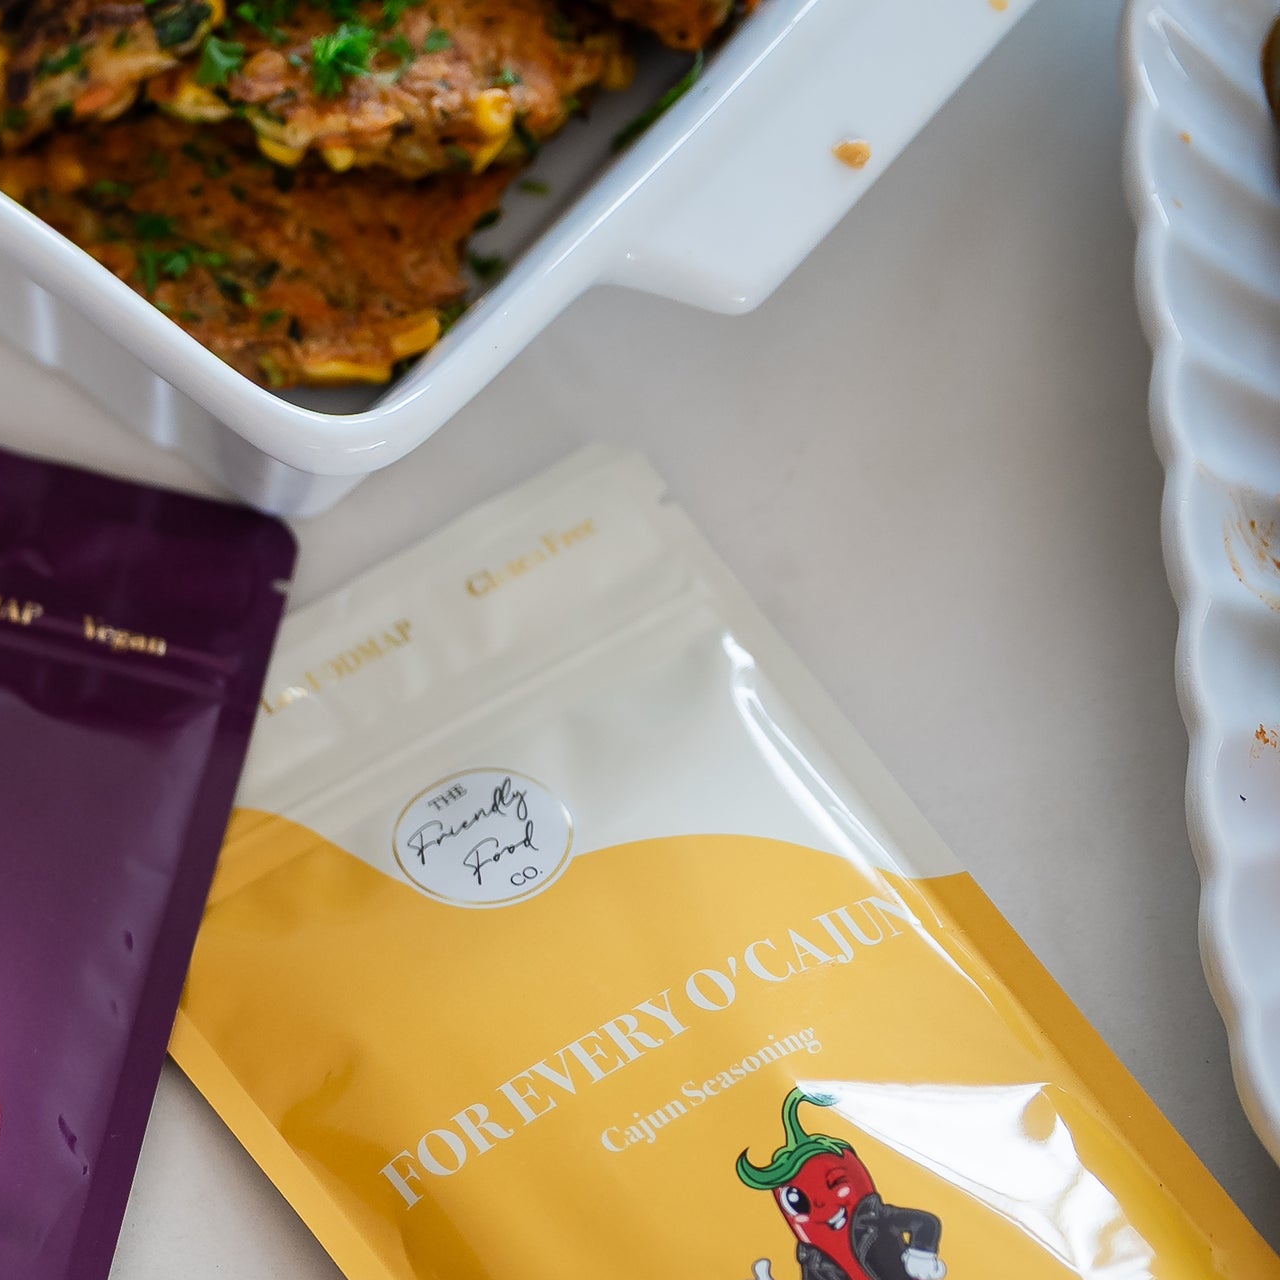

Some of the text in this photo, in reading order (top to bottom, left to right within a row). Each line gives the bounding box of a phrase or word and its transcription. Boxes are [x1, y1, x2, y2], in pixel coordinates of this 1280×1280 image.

[83, 614, 168, 657] Vegan
[406, 776, 529, 866] Friendly
[426, 782, 468, 813] THE
[462, 819, 540, 886] Food
[377, 1101, 515, 1213] FOR
[495, 988, 692, 1127] EVERY
[600, 1023, 823, 1155] Cajun Seasoning
